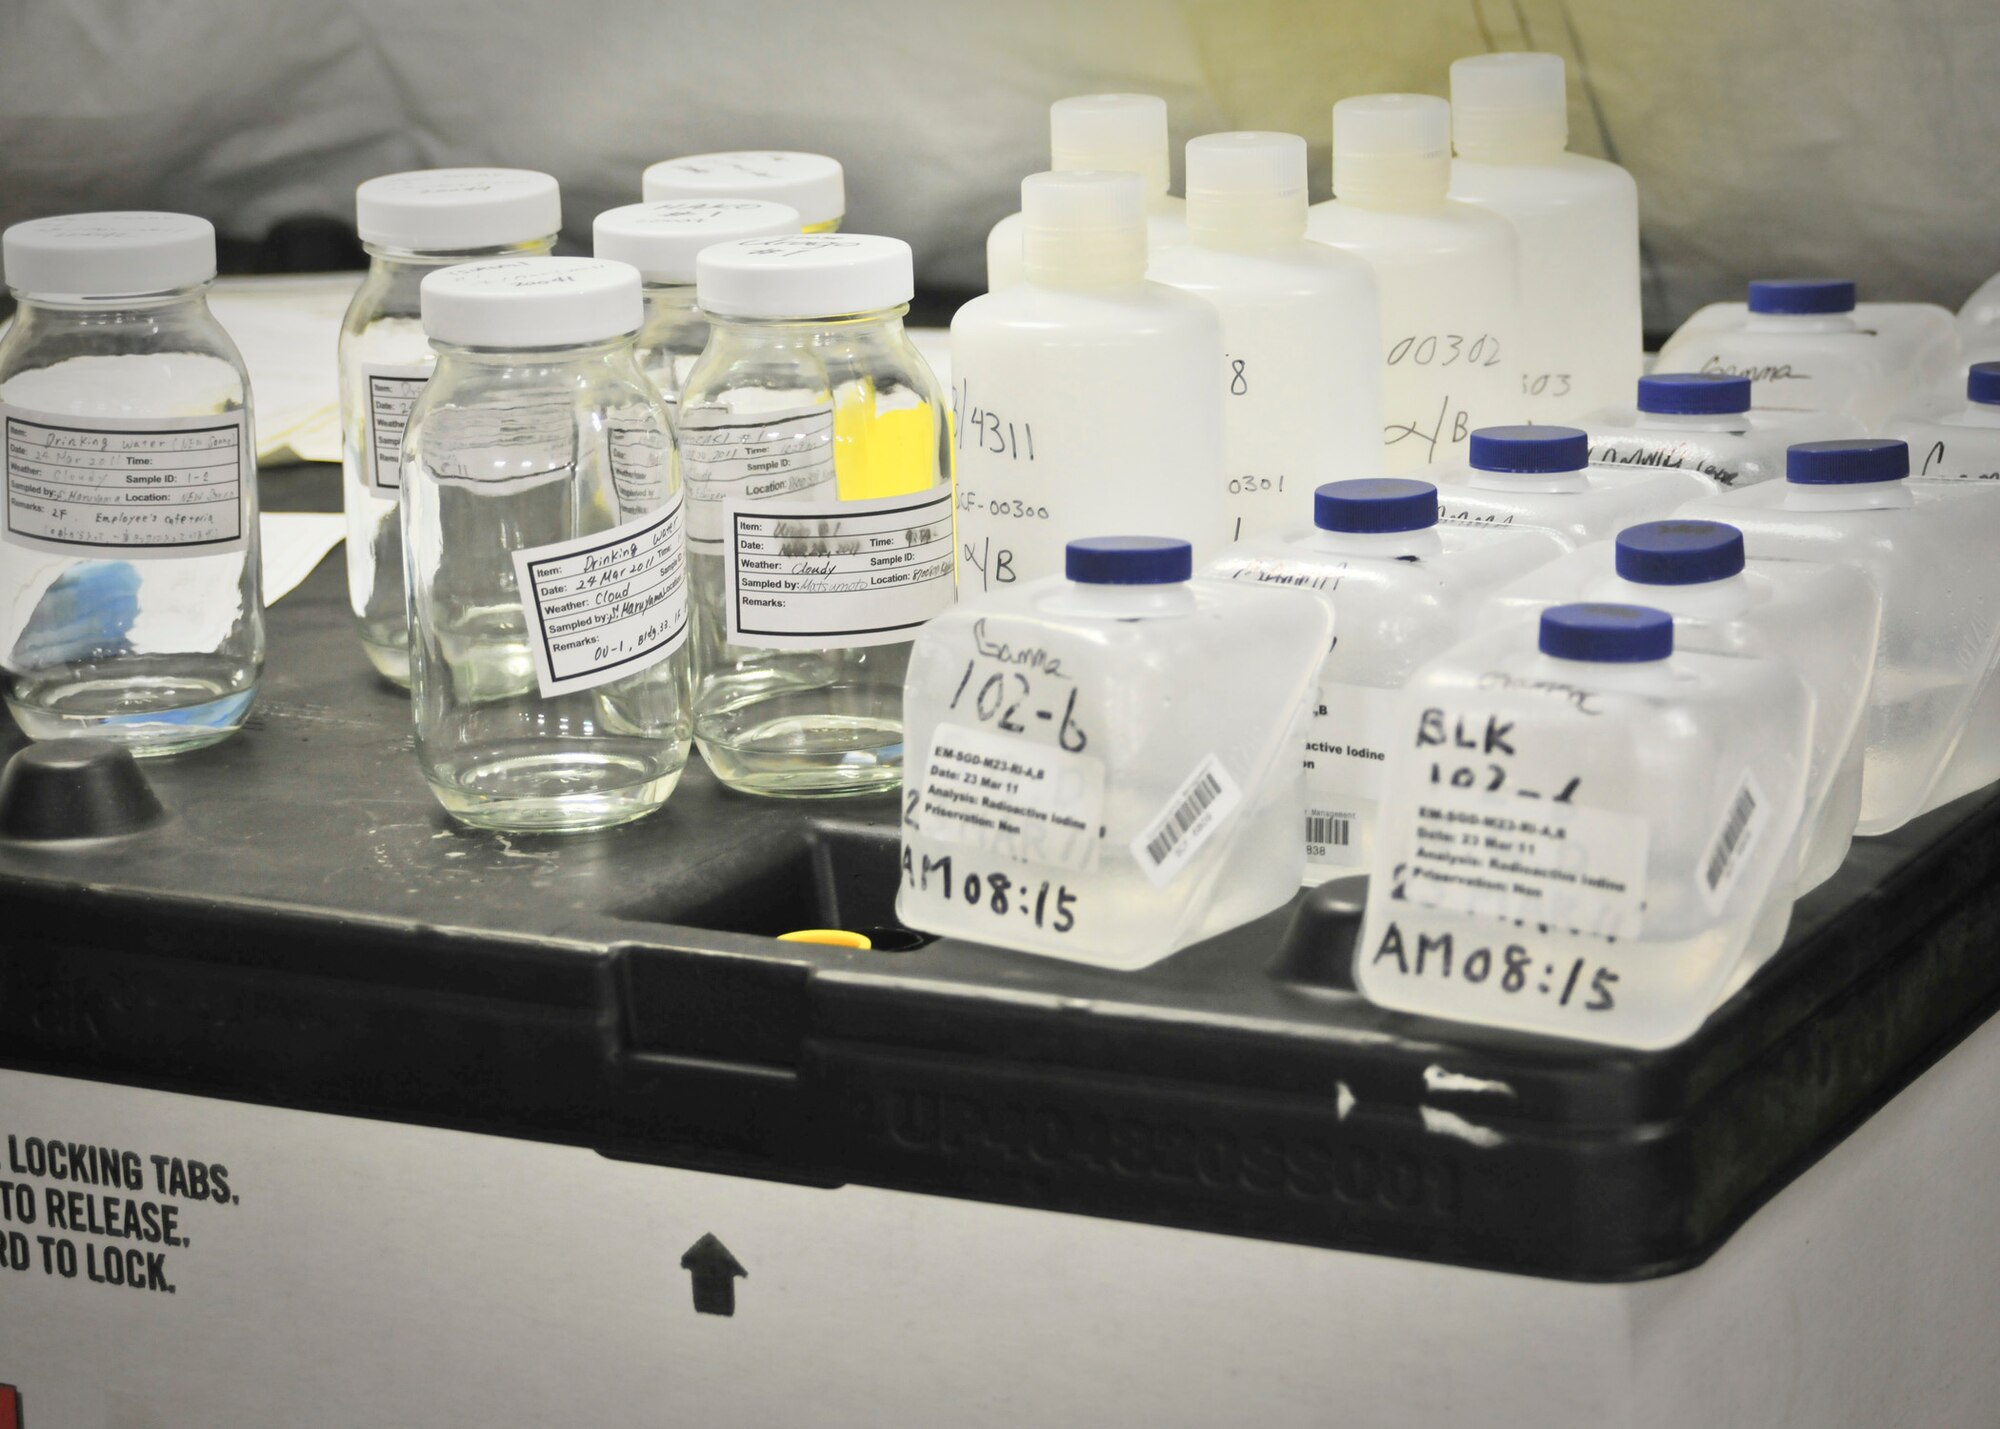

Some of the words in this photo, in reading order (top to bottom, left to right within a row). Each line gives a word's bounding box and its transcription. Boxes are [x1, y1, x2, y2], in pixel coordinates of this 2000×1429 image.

[1230, 359, 1248, 396] 8
[377, 419, 405, 429] Weathe
[44, 433, 108, 451] Drinking
[745, 446, 770, 455] Time:
[126, 456, 152, 465] Time:
[747, 461, 779, 472] Sample
[11, 462, 42, 476] Weather:
[126, 475, 162, 485] Sample
[164, 474, 177, 483] ID:
[11, 479, 41, 494] Sampled
[126, 493, 171, 502] Location:
[746, 480, 787, 495] Location:
[740, 522, 763, 531] Item:
[740, 540, 764, 550] Date:
[870, 538, 894, 547] Time:
[536, 566, 562, 578] Item:
[583, 543, 638, 574] Drinking
[741, 560, 782, 570] Weather:
[791, 562, 838, 581] Cloudy
[870, 555, 903, 566] Sample
[904, 552, 915, 561] ID:
[541, 585, 568, 597] Date:
[575, 575, 597, 591] 24
[600, 568, 626, 586] Mar
[630, 556, 655, 573] 2011
[741, 578, 783, 591] Sampled
[784, 580, 800, 591] by:
[799, 578, 869, 592] Matsumoto
[871, 573, 910, 585] Location:
[544, 599, 590, 615] Weather:
[595, 581, 631, 605] Cloud
[742, 597, 786, 608] Remarks:
[548, 616, 593, 634] Sampled
[552, 635, 600, 653] Remarks:
[950, 659, 1088, 753] 102-6
[1415, 706, 1517, 757] BLK
[1346, 744, 1386, 761] Iodine
[930, 764, 961, 781] Date:
[963, 772, 978, 785] 23
[980, 776, 1003, 791] Mar
[1005, 782, 1019, 795] 11
[927, 784, 979, 806] Analysis:
[981, 796, 1049, 822] Radioactive
[998, 820, 1021, 835] Non
[7, 1133, 144, 1191] LOCKING
[150, 1154, 240, 1206] TABS.
[0, 1179, 37, 1225] TO
[45, 1187, 191, 1249] RELEASE.
[37, 1235, 78, 1279] TO
[86, 1242, 176, 1294] LOCK.
